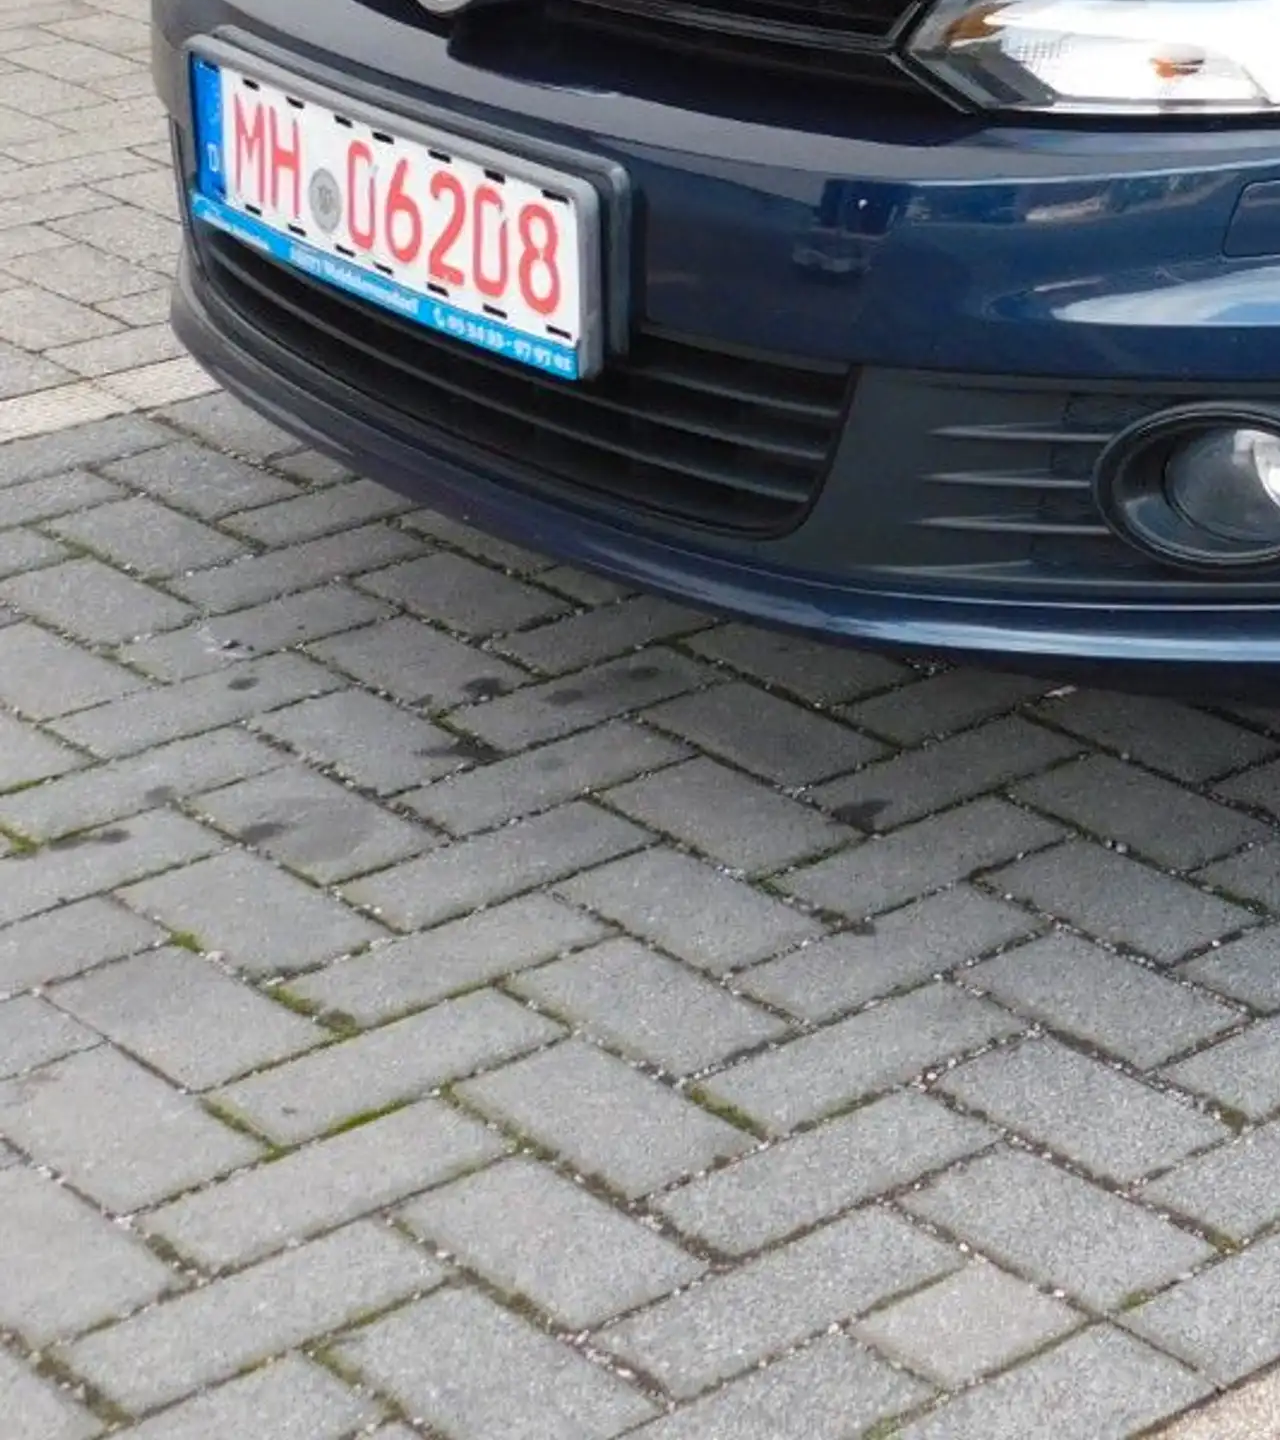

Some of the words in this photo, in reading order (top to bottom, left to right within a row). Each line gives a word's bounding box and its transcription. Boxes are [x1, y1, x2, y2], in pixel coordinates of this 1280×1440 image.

[207, 143, 220, 172] D
[233, 92, 301, 219] MH
[347, 140, 561, 315] 06208
